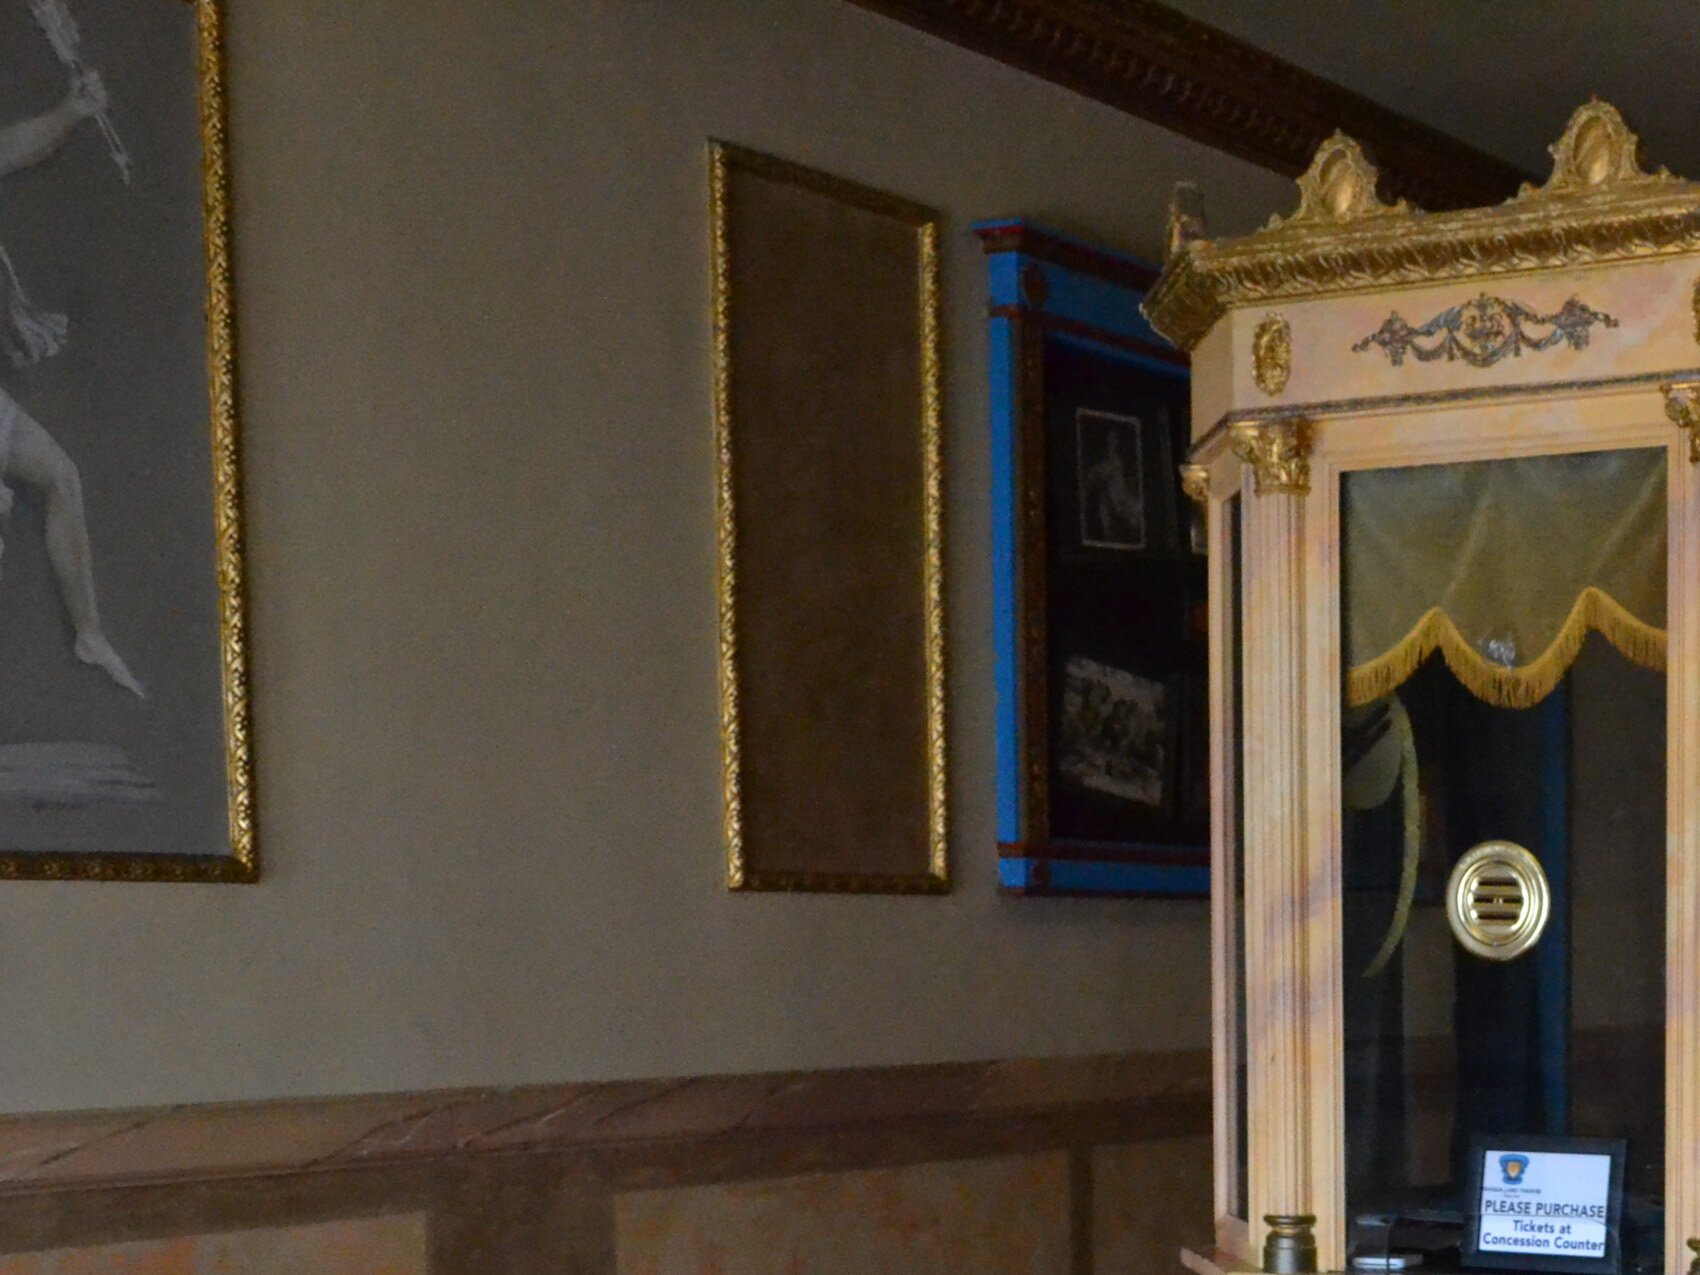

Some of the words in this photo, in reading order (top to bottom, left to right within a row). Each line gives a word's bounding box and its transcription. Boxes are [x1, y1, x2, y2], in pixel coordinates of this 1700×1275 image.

[1484, 1200, 1531, 1214] PLEASE
[1535, 1203, 1604, 1218] PURCHASE
[1513, 1220, 1555, 1234] Tickets
[1559, 1224, 1572, 1235] at
[1482, 1232, 1550, 1248] Concession
[1554, 1236, 1605, 1251] Counter
